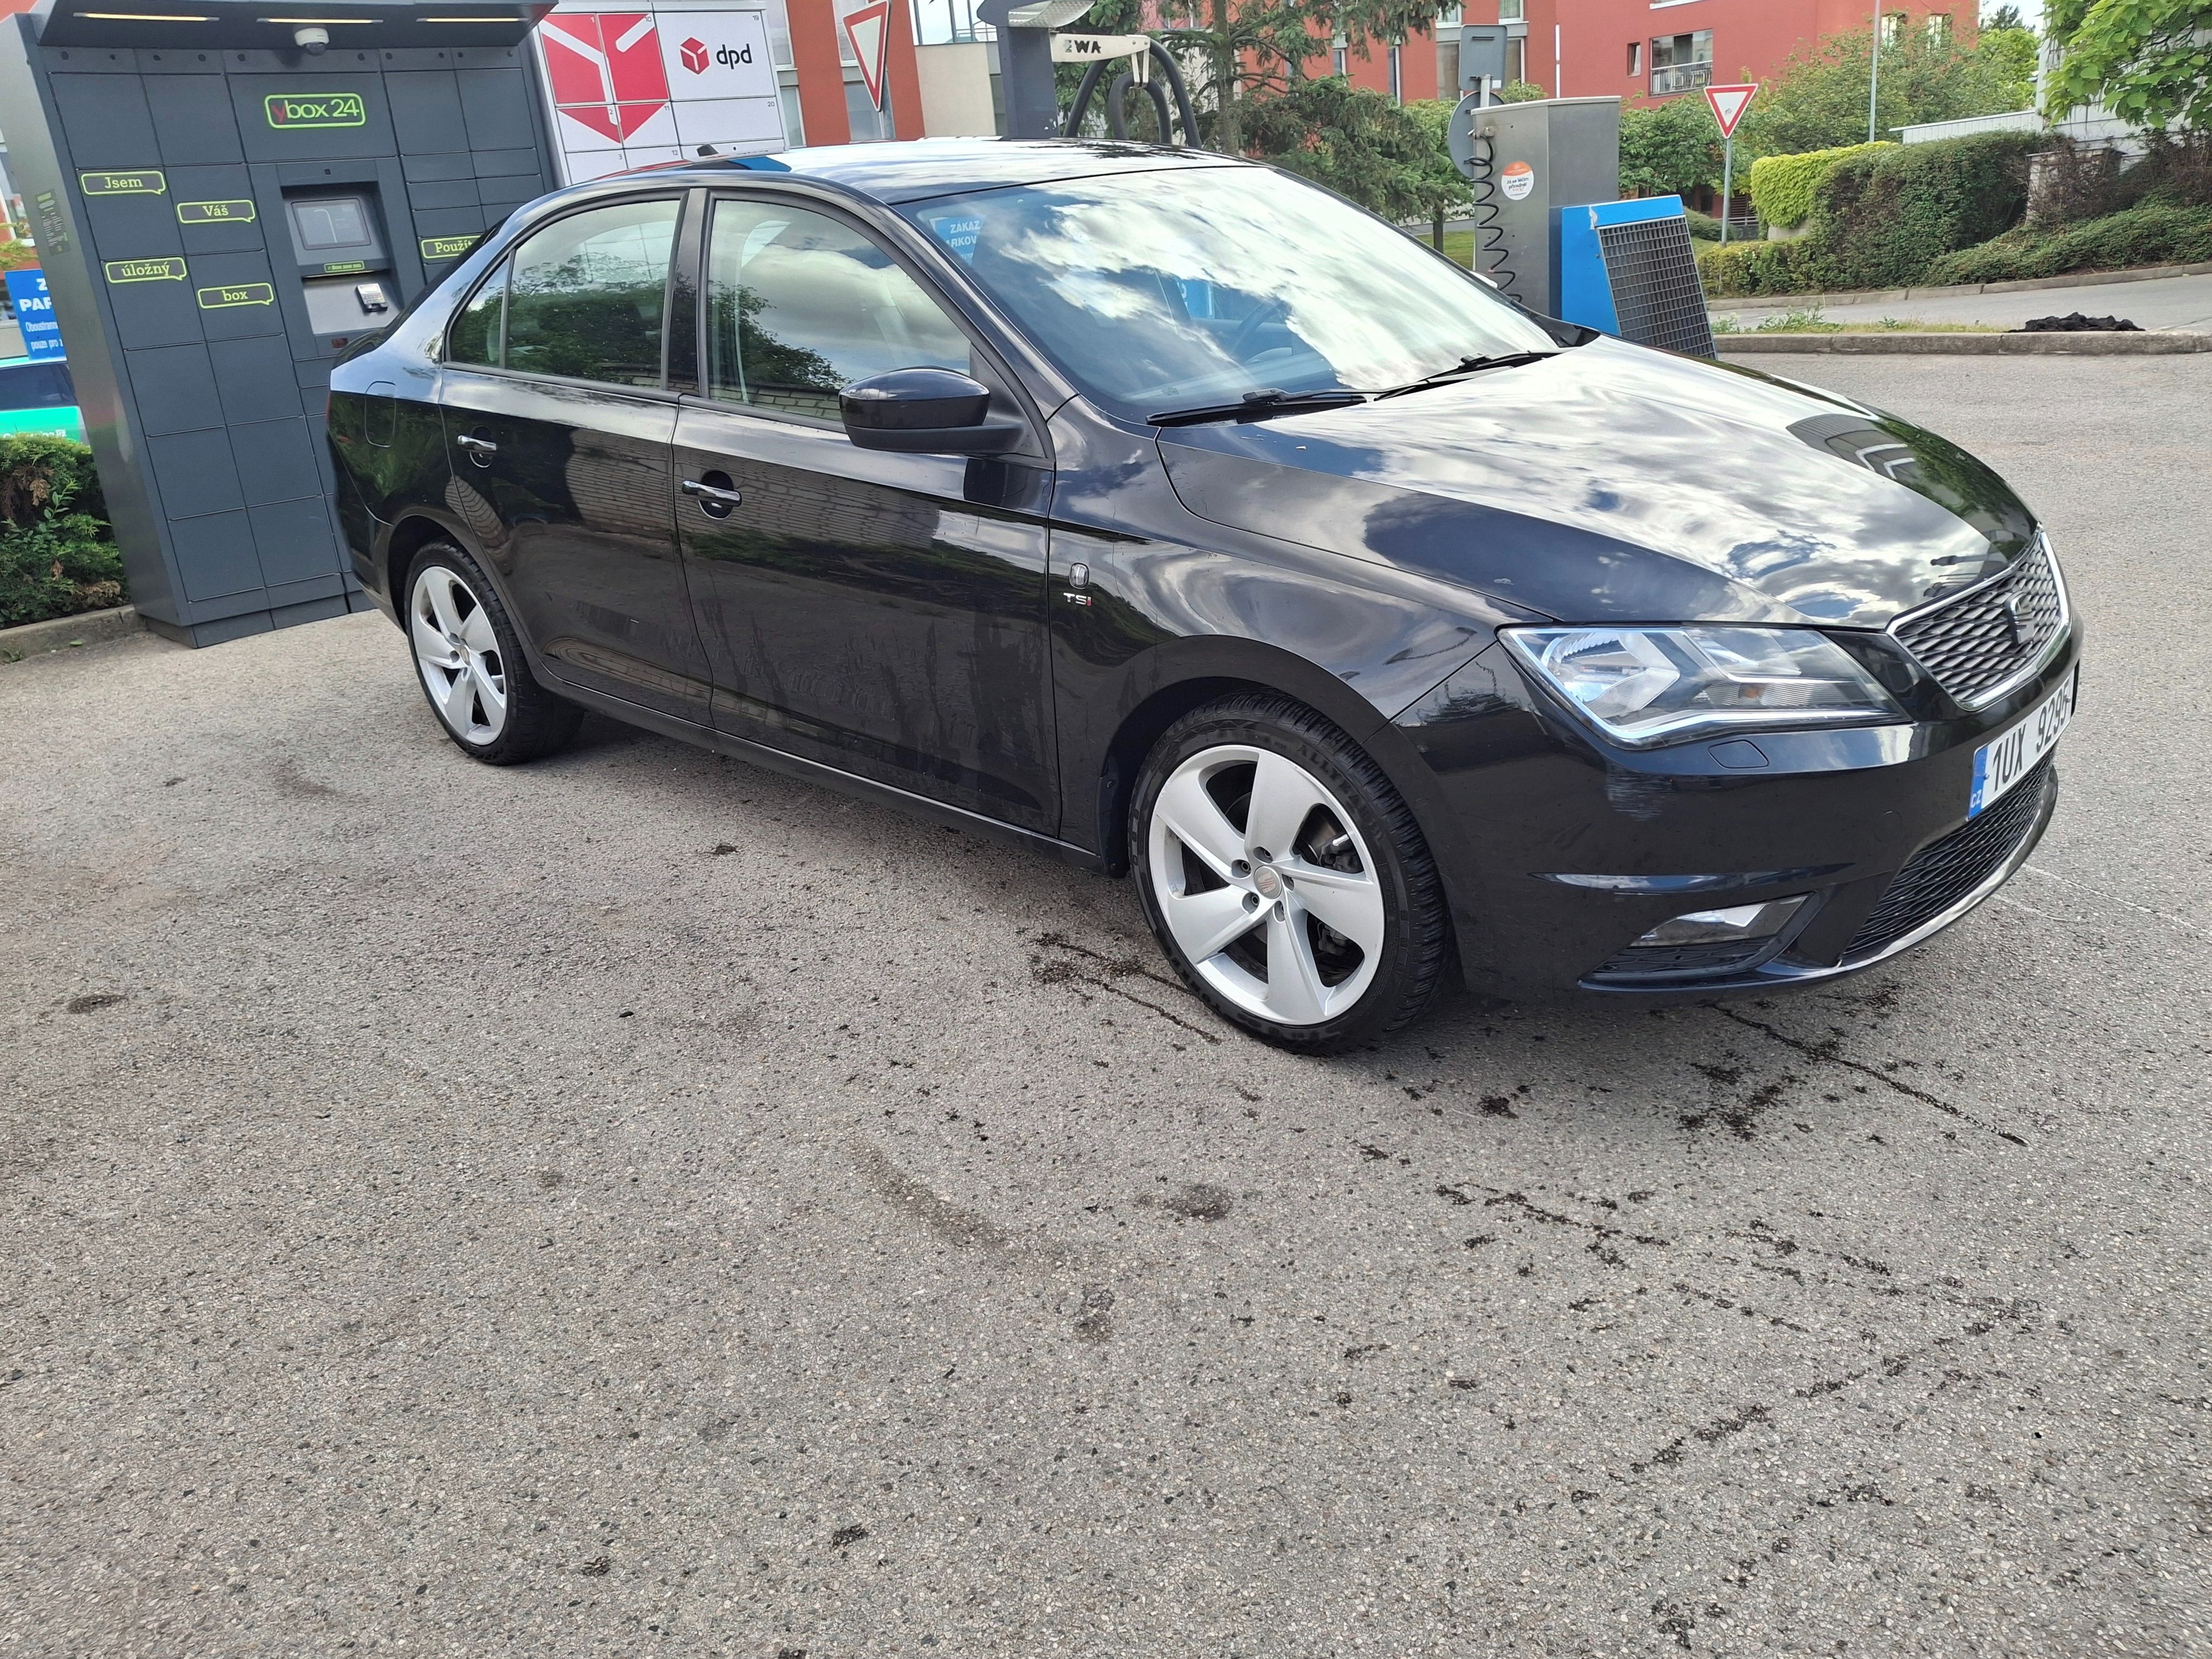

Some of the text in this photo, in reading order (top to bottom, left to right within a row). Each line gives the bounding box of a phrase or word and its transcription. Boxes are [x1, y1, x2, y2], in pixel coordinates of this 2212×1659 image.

[716, 43, 753, 69] dpd
[104, 177, 143, 189] Jsem
[202, 204, 229, 216] Váš
[950, 220, 981, 234] ZÁKAZ
[121, 261, 170, 276] úložný
[222, 290, 249, 301] box
[1993, 723, 2027, 793] 1UX
[1971, 789, 1982, 808] CZ
